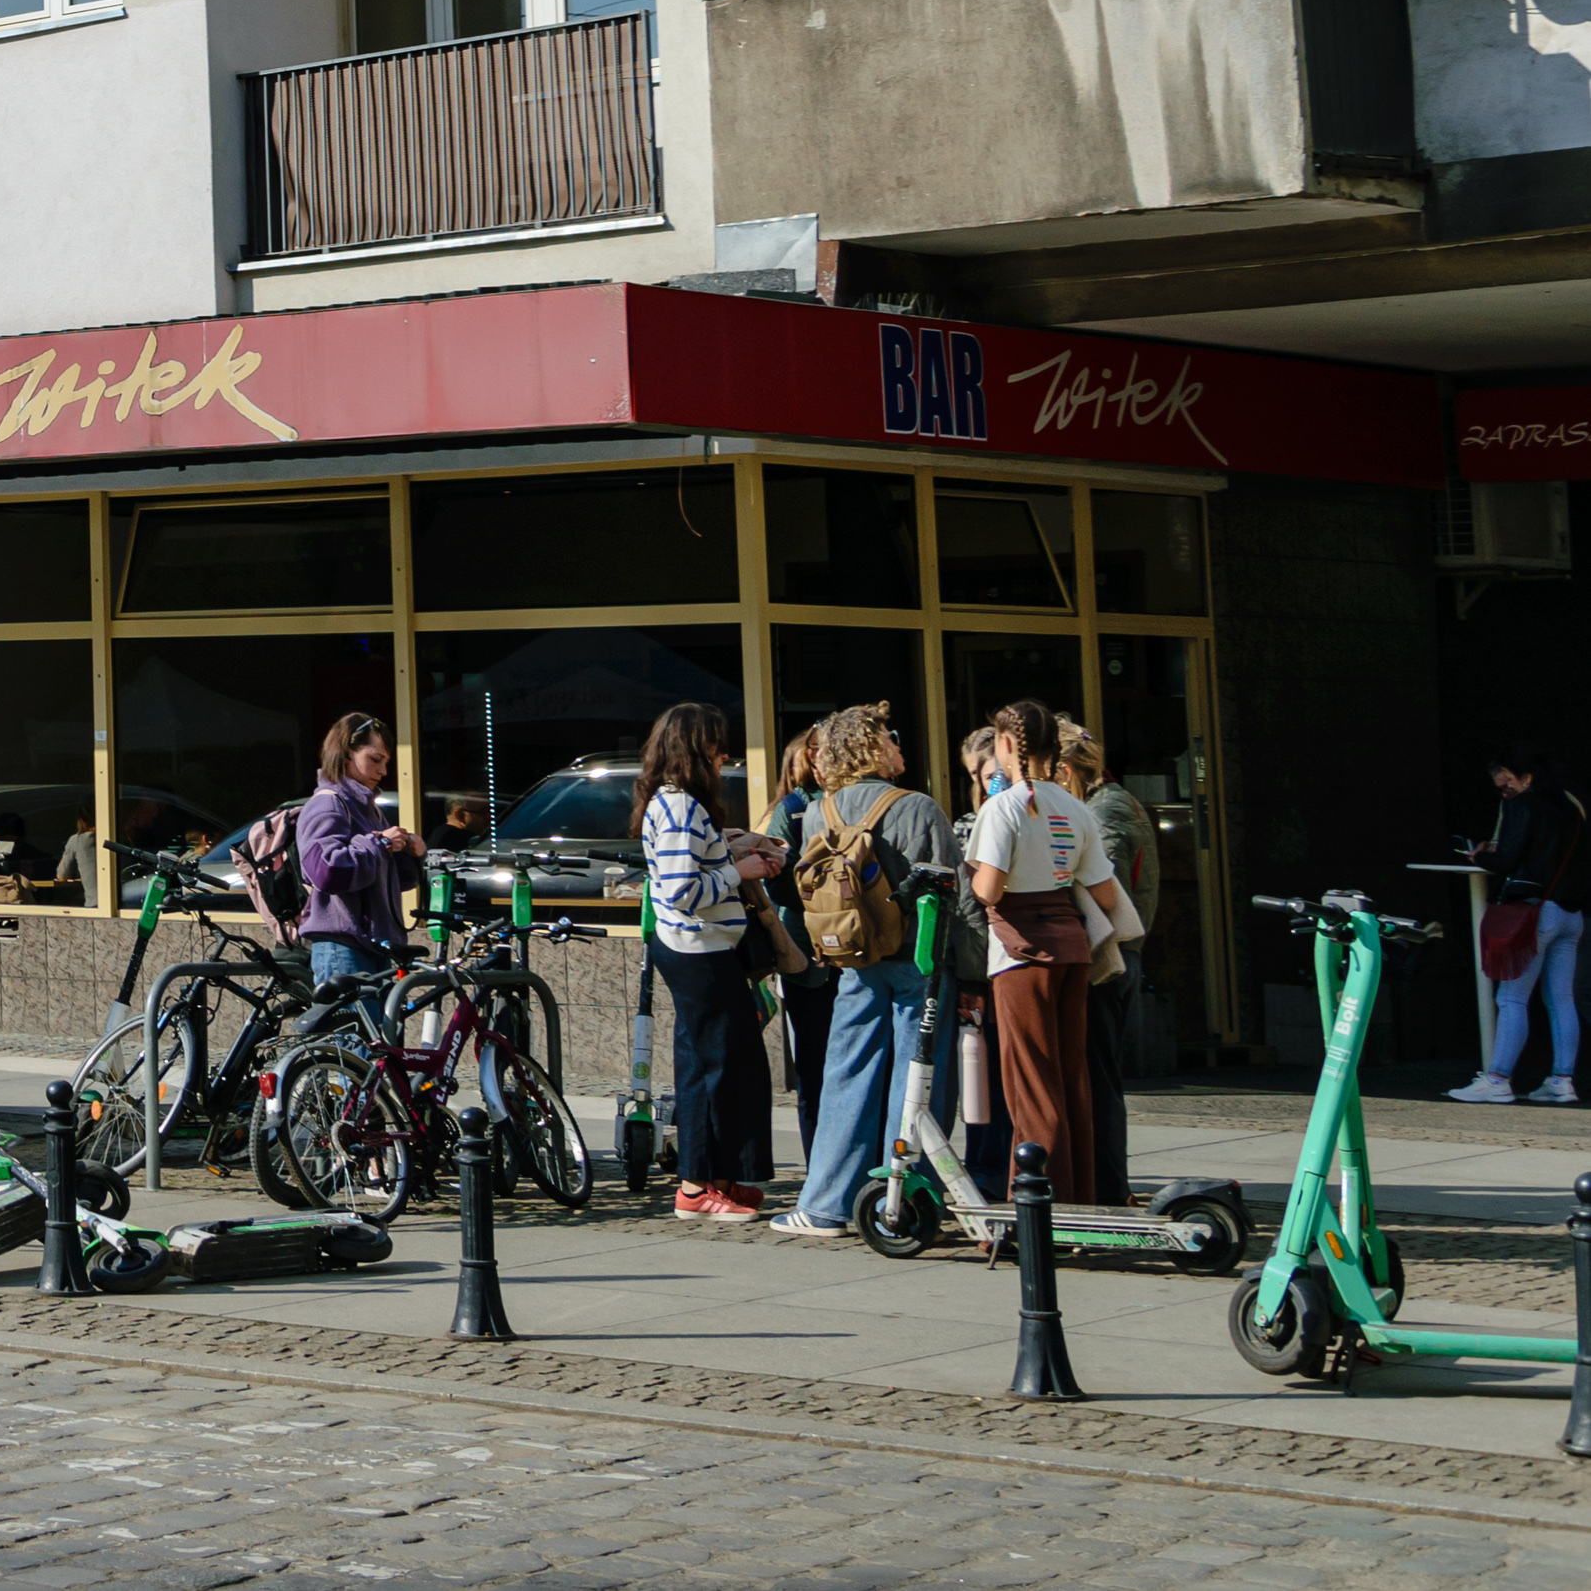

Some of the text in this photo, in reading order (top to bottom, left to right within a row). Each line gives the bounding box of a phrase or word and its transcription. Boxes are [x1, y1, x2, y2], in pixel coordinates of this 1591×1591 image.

[878, 322, 1229, 466] BAR Witek
[1459, 421, 1591, 450] ZAPRAS
[1334, 996, 1359, 1036] Bolt
